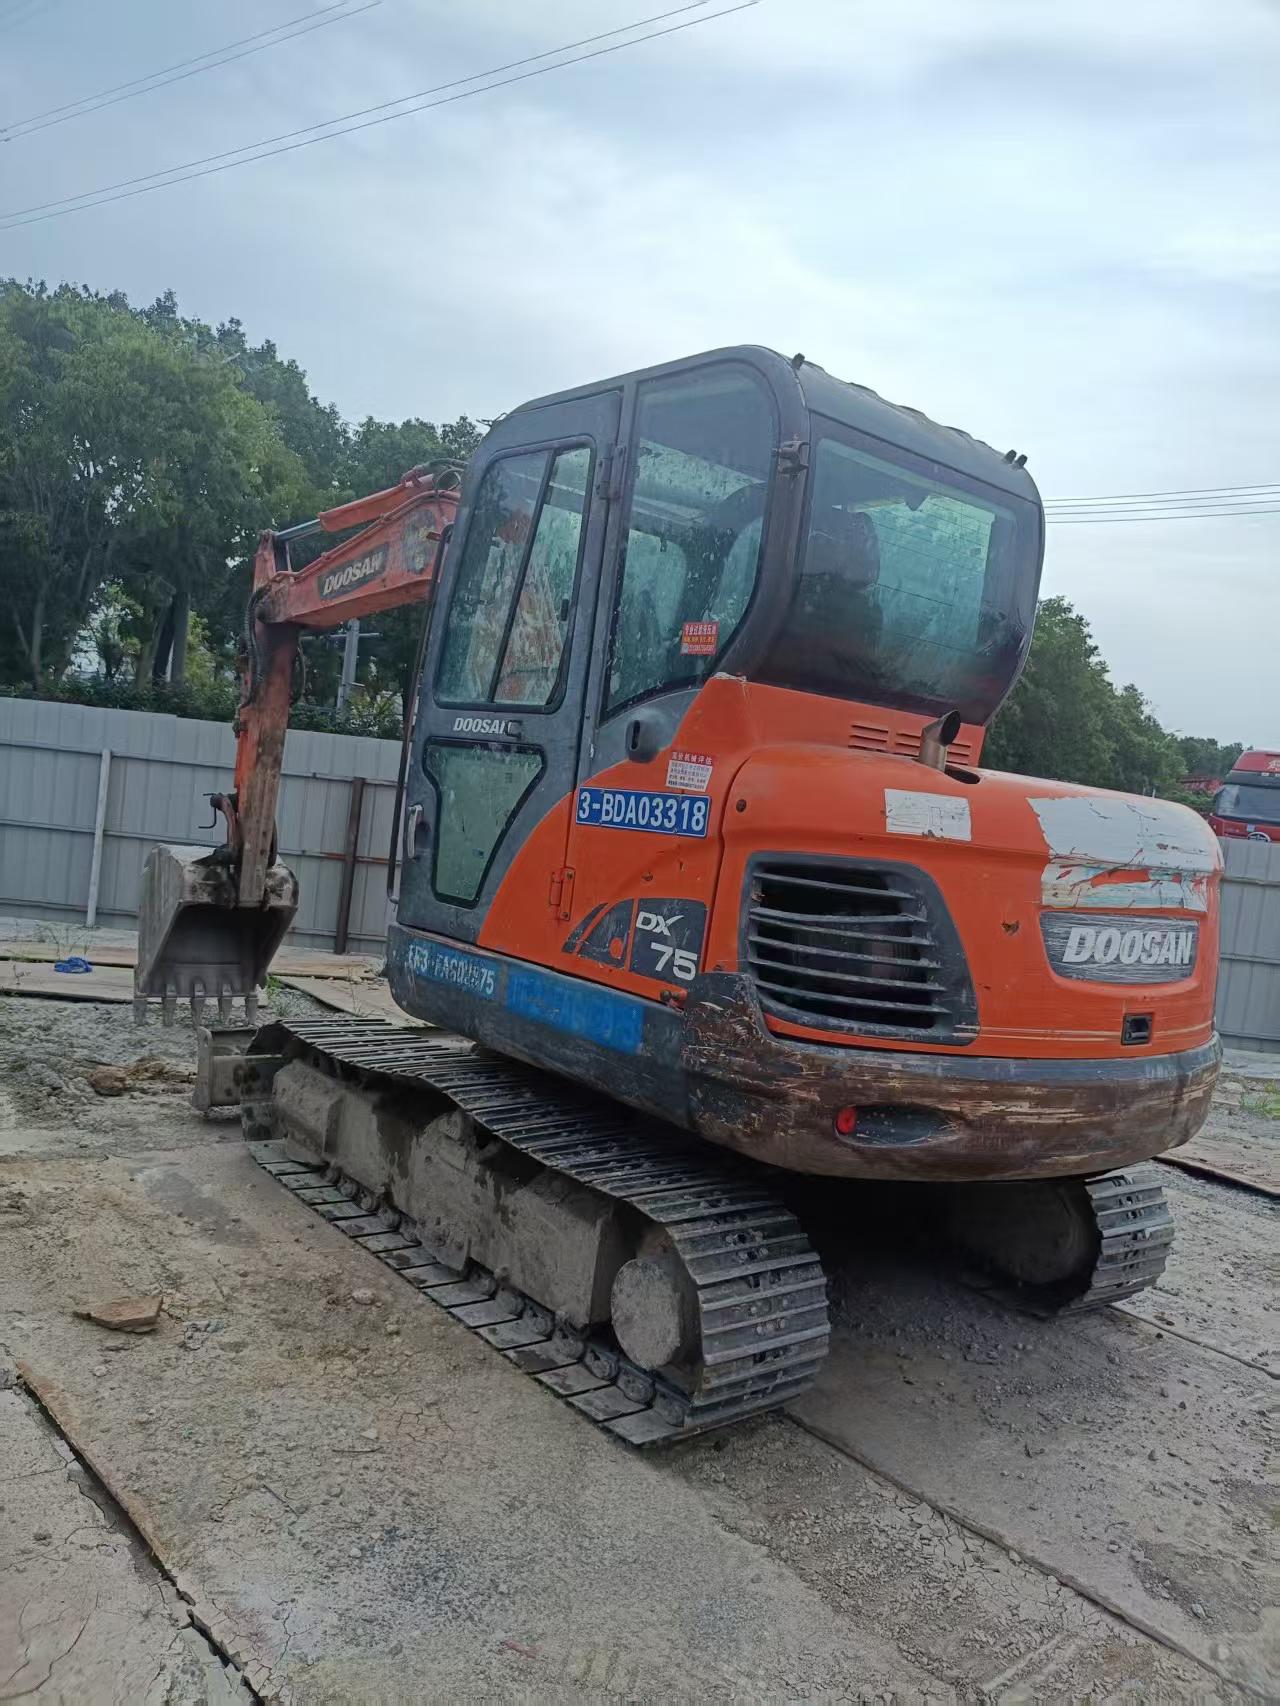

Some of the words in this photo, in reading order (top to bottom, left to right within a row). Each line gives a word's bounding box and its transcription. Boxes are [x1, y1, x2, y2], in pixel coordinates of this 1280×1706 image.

[323, 551, 384, 595] DOOSAN
[578, 791, 705, 832] 3-BDA03318
[636, 911, 684, 936] DX
[651, 942, 697, 981] 75
[1062, 927, 1193, 965] DOOSAN
